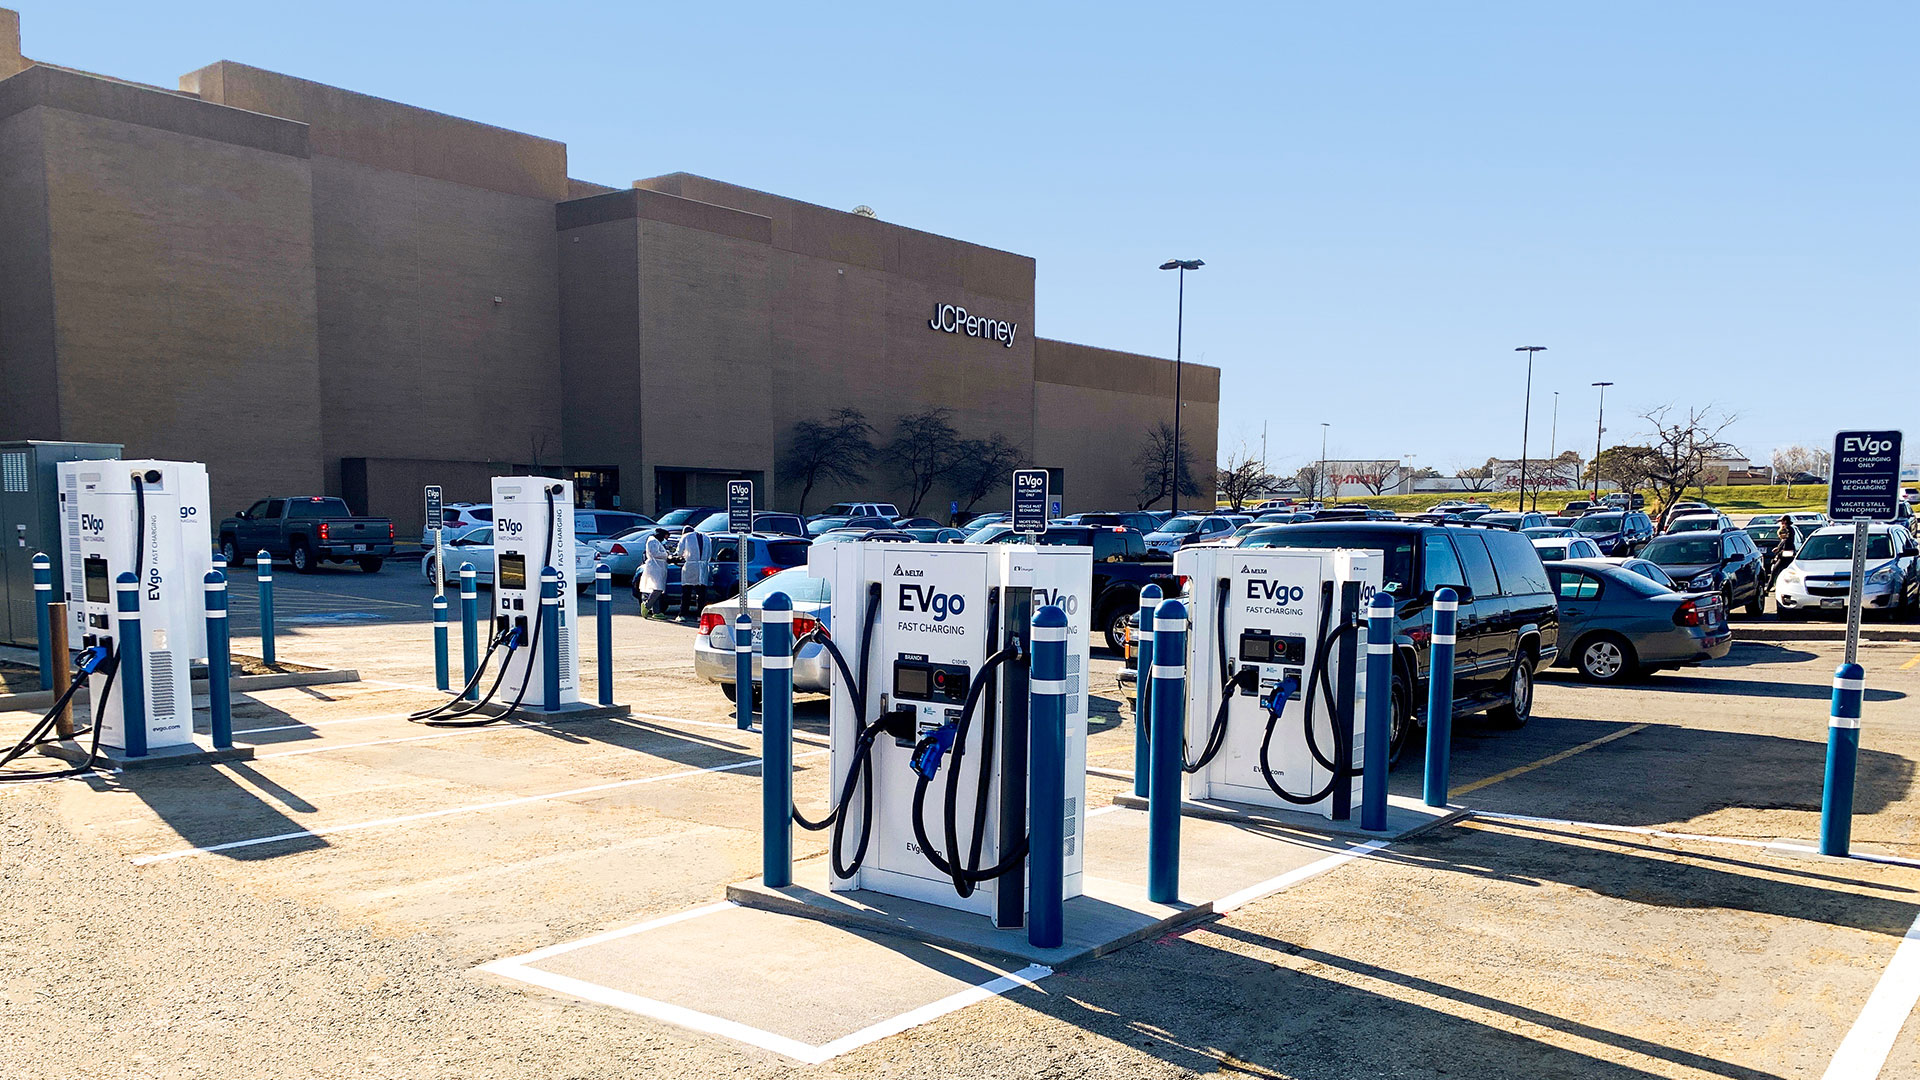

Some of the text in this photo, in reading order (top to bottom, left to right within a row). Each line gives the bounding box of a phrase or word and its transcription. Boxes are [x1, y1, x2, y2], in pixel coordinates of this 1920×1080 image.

[930, 303, 1017, 347] JCPenney
[1844, 437, 1892, 455] EVgo
[1019, 475, 1042, 488] EVgo
[732, 485, 749, 496] EVgo
[82, 514, 104, 535] EVgo
[498, 519, 522, 535] EVgo
[147, 568, 162, 600] EVgo
[1247, 579, 1304, 606] EVgo
[899, 584, 966, 622] EVgo
[1264, 607, 1304, 616] CHARGING
[898, 622, 965, 635] FAST CHARGING
[1254, 766, 1285, 776] EVcom
